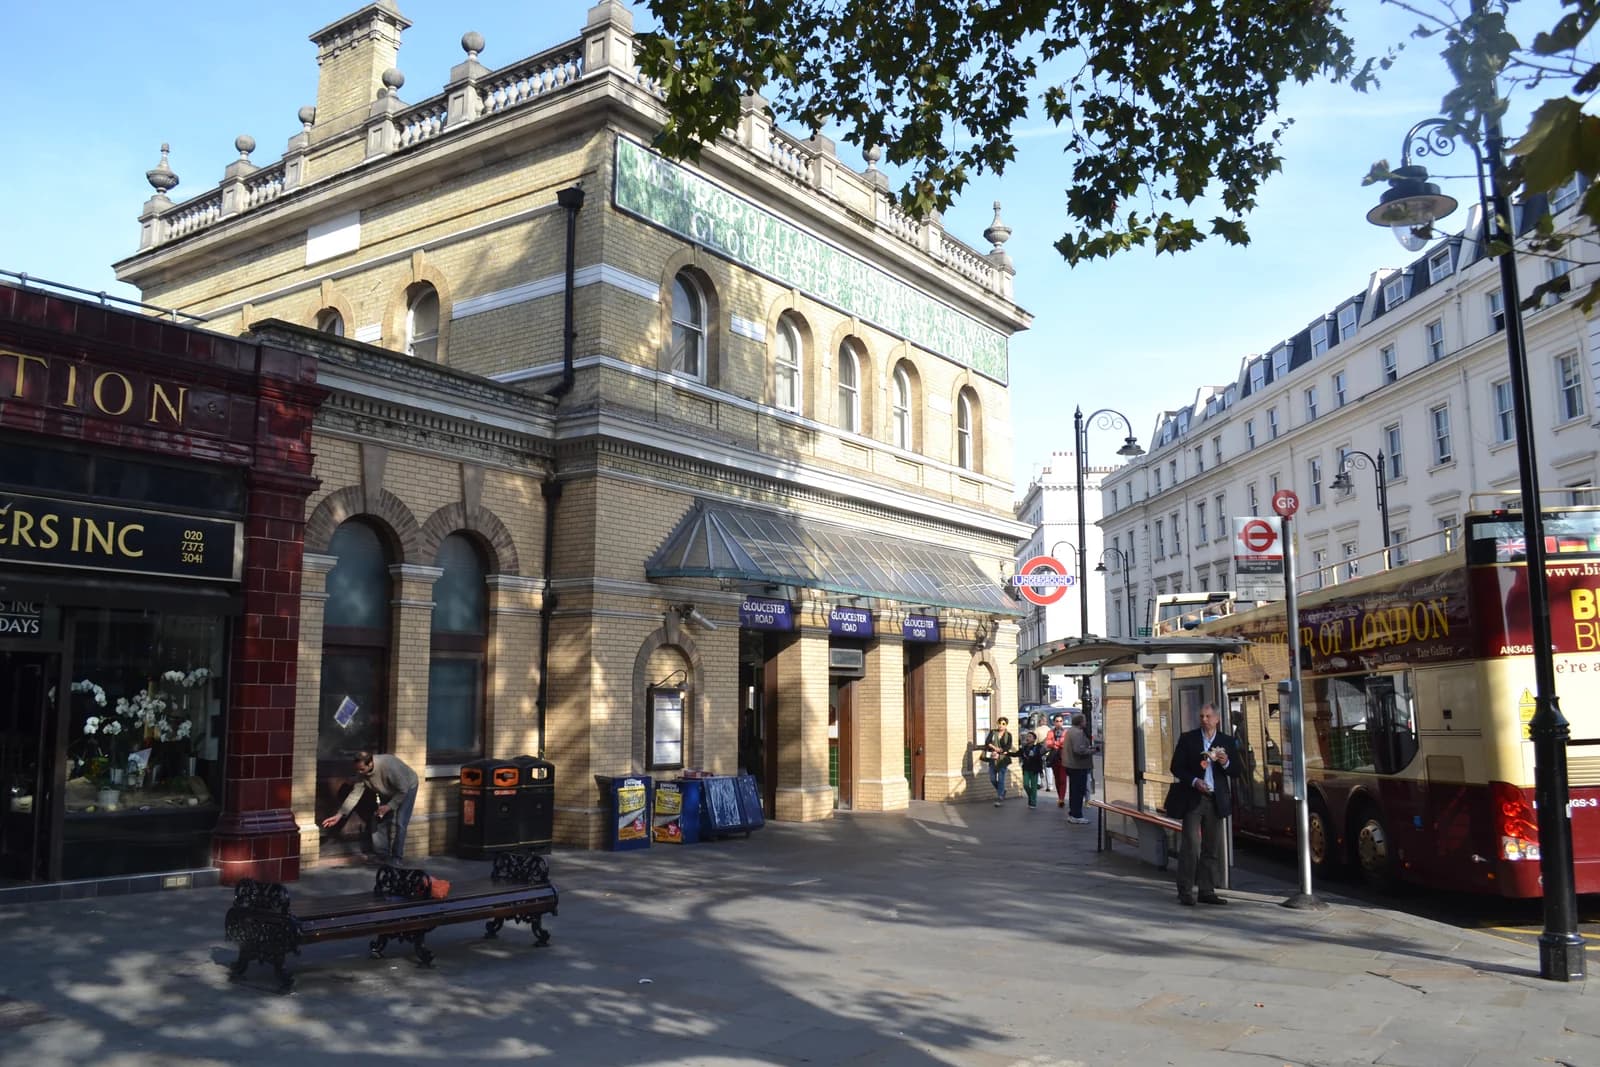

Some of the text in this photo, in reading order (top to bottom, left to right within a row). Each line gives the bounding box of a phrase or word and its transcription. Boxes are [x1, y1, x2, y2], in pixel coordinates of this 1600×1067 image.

[636, 153, 825, 267] METROPOLITAN
[0, 350, 190, 426] TION
[1276, 498, 1296, 509] GR
[70, 516, 145, 558] INC
[184, 530, 203, 541] 020
[181, 541, 204, 552] 7373
[182, 553, 203, 564] 3041
[1545, 563, 1600, 577] www.bi
[1014, 576, 1074, 586] UNDERGROUND
[743, 601, 786, 614] GLOUCESTER
[754, 614, 774, 625] ROAD
[831, 612, 867, 623] GLOUCESTER
[841, 622, 858, 632] ROAD
[904, 618, 934, 629] GLOUCESTER
[1320, 619, 1344, 656] OF
[1350, 596, 1450, 653] LONDON
[912, 629, 926, 638] ROAD
[1556, 660, 1587, 673] e're
